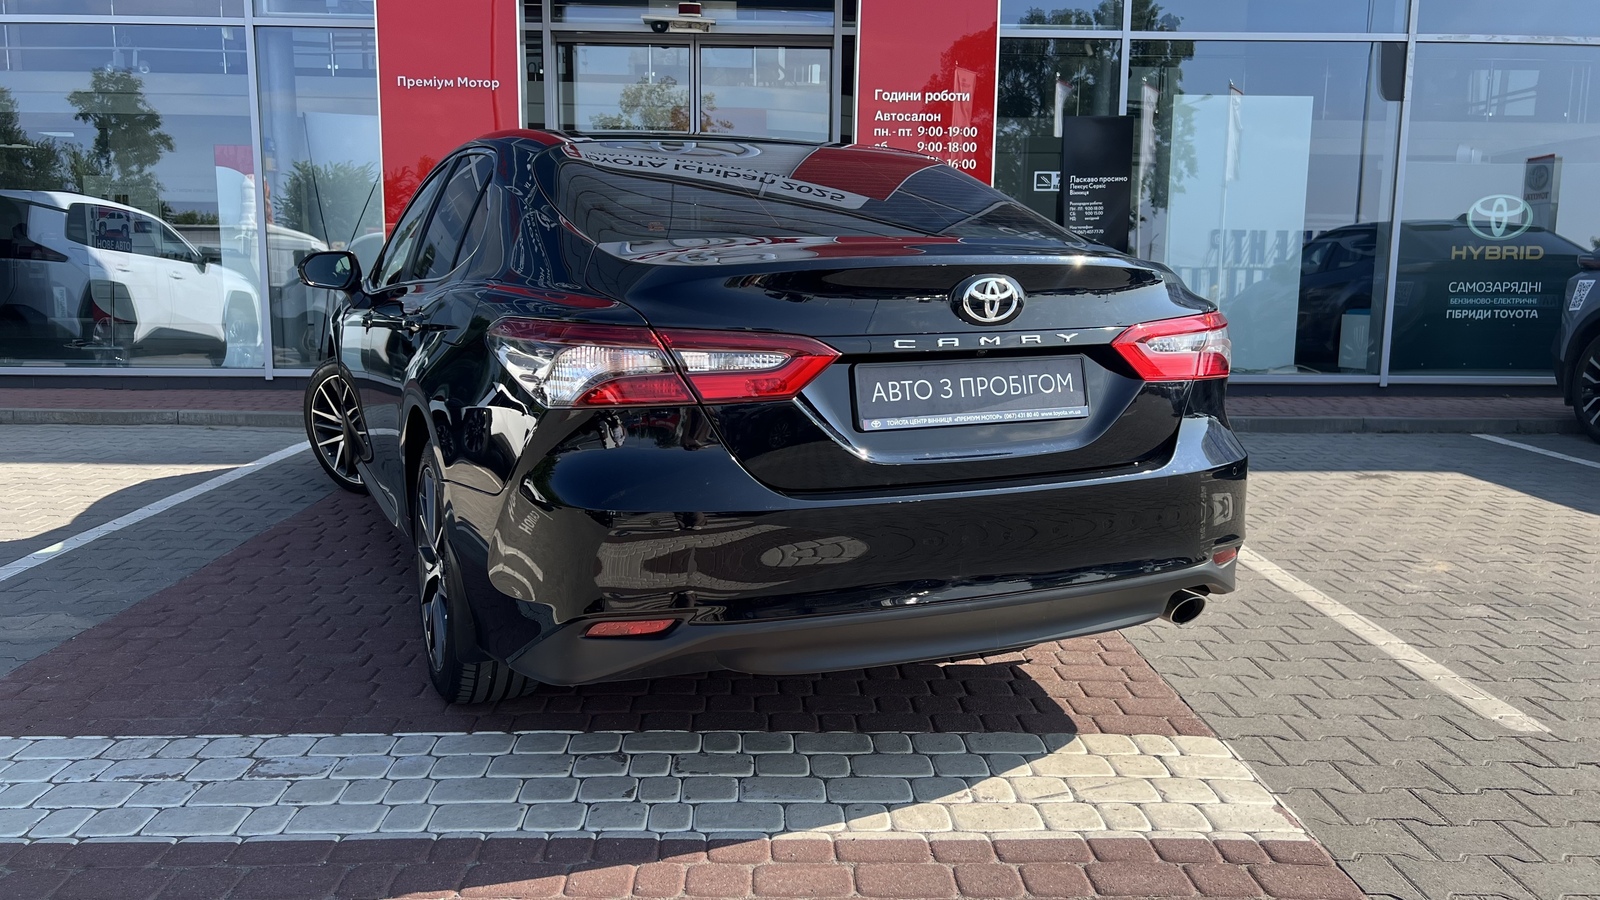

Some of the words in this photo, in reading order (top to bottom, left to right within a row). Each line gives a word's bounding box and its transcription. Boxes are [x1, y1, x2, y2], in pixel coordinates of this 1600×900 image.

[397, 76, 453, 90] Преміум
[457, 77, 500, 90] Мотор
[874, 89, 921, 103] Години
[925, 89, 970, 104] роботи
[874, 110, 941, 122] Автосалон
[917, 126, 978, 137] 9:00-19:00
[917, 141, 977, 153] 9:00-18:00
[947, 159, 977, 170] 16:00
[1069, 175, 1098, 183] Ласкаво
[1099, 176, 1128, 184] просимо
[97, 239, 114, 249] НОВЕ
[115, 240, 131, 251] АВТО
[1451, 245, 1544, 260] HYBRID
[1448, 281, 1541, 294] САМОЗАРЯДНІ
[1450, 297, 1537, 305] БЕНЗИНОВО-ЕЛЕКТРИЧНІ
[1446, 309, 1491, 320] ГІБРИДИ
[1493, 309, 1538, 319] TOYOTA
[893, 332, 1079, 348] CAMRY
[872, 379, 933, 403] АВТО
[940, 378, 953, 399] З
[960, 373, 1074, 398] ПРОБІГОМ
[887, 418, 909, 426] ТОЙОТА
[910, 418, 928, 426] ЦЕНТР
